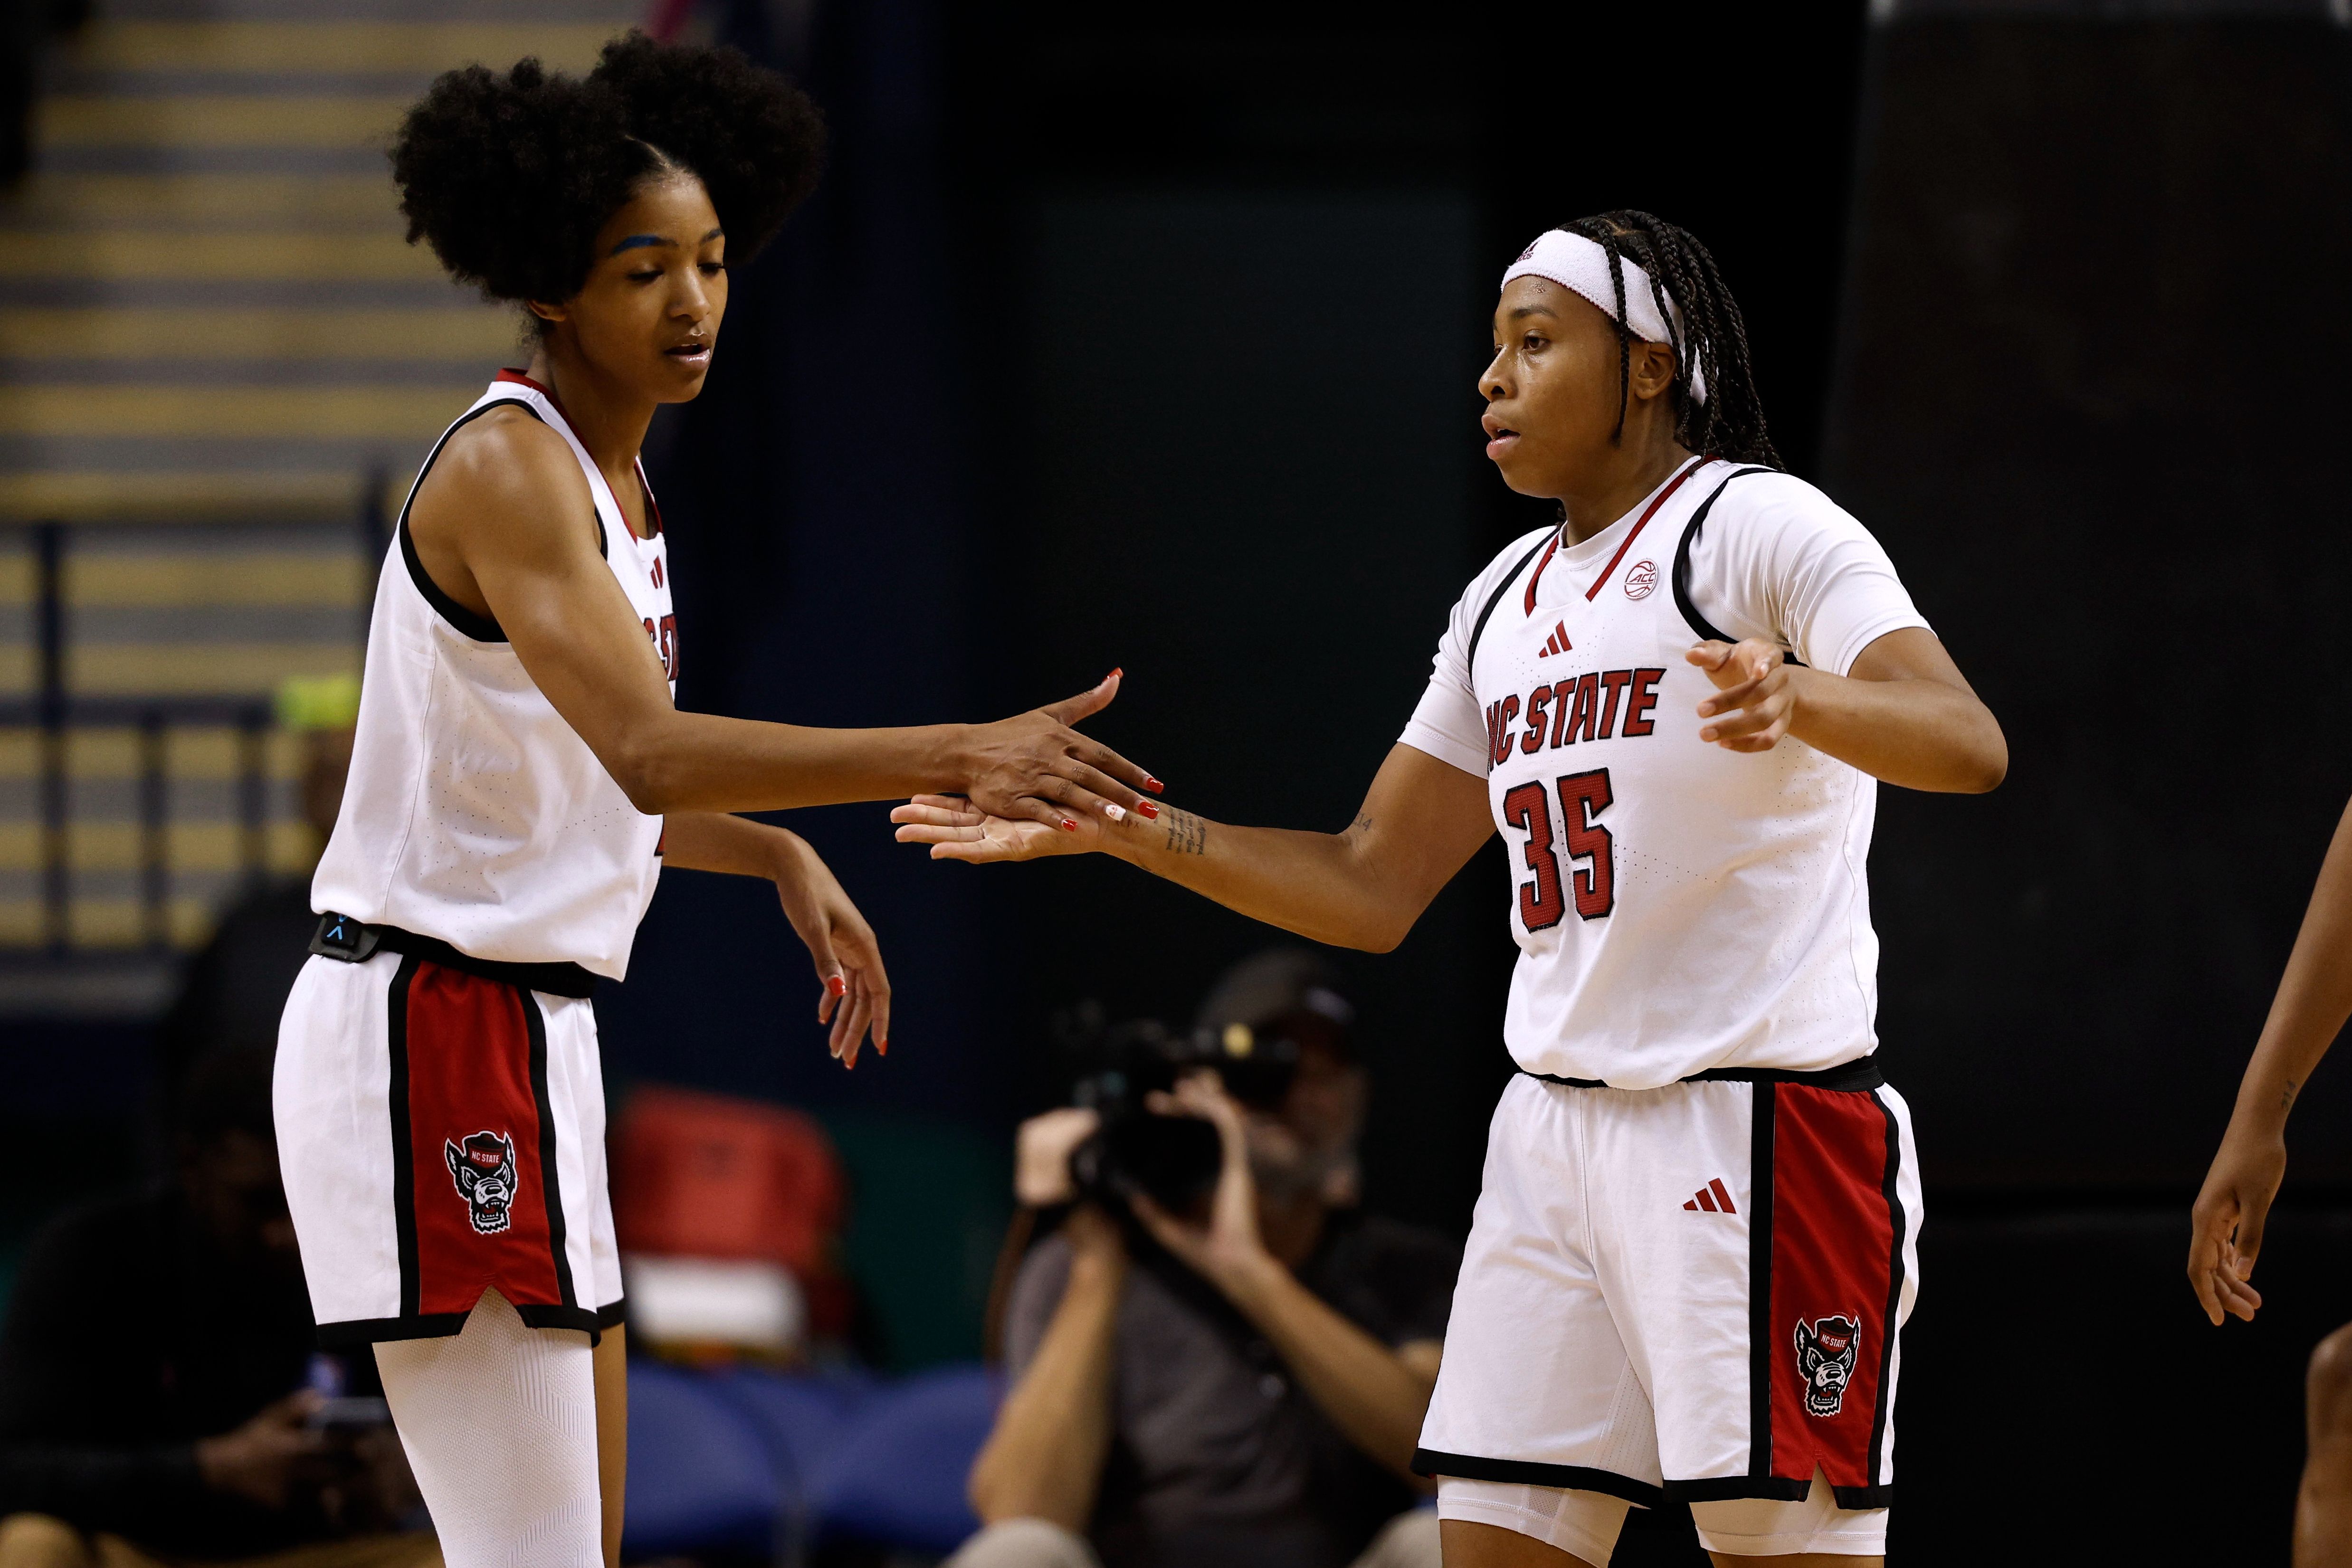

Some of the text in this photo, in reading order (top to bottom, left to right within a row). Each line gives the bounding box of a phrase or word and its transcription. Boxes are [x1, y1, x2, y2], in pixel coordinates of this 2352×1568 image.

[1629, 572, 1656, 582] ACC
[1486, 668, 1667, 772] NC STATE
[1503, 767, 1614, 934] 35
[472, 1150, 499, 1163] NC STATE
[1821, 1334, 1846, 1348] NC STATE
